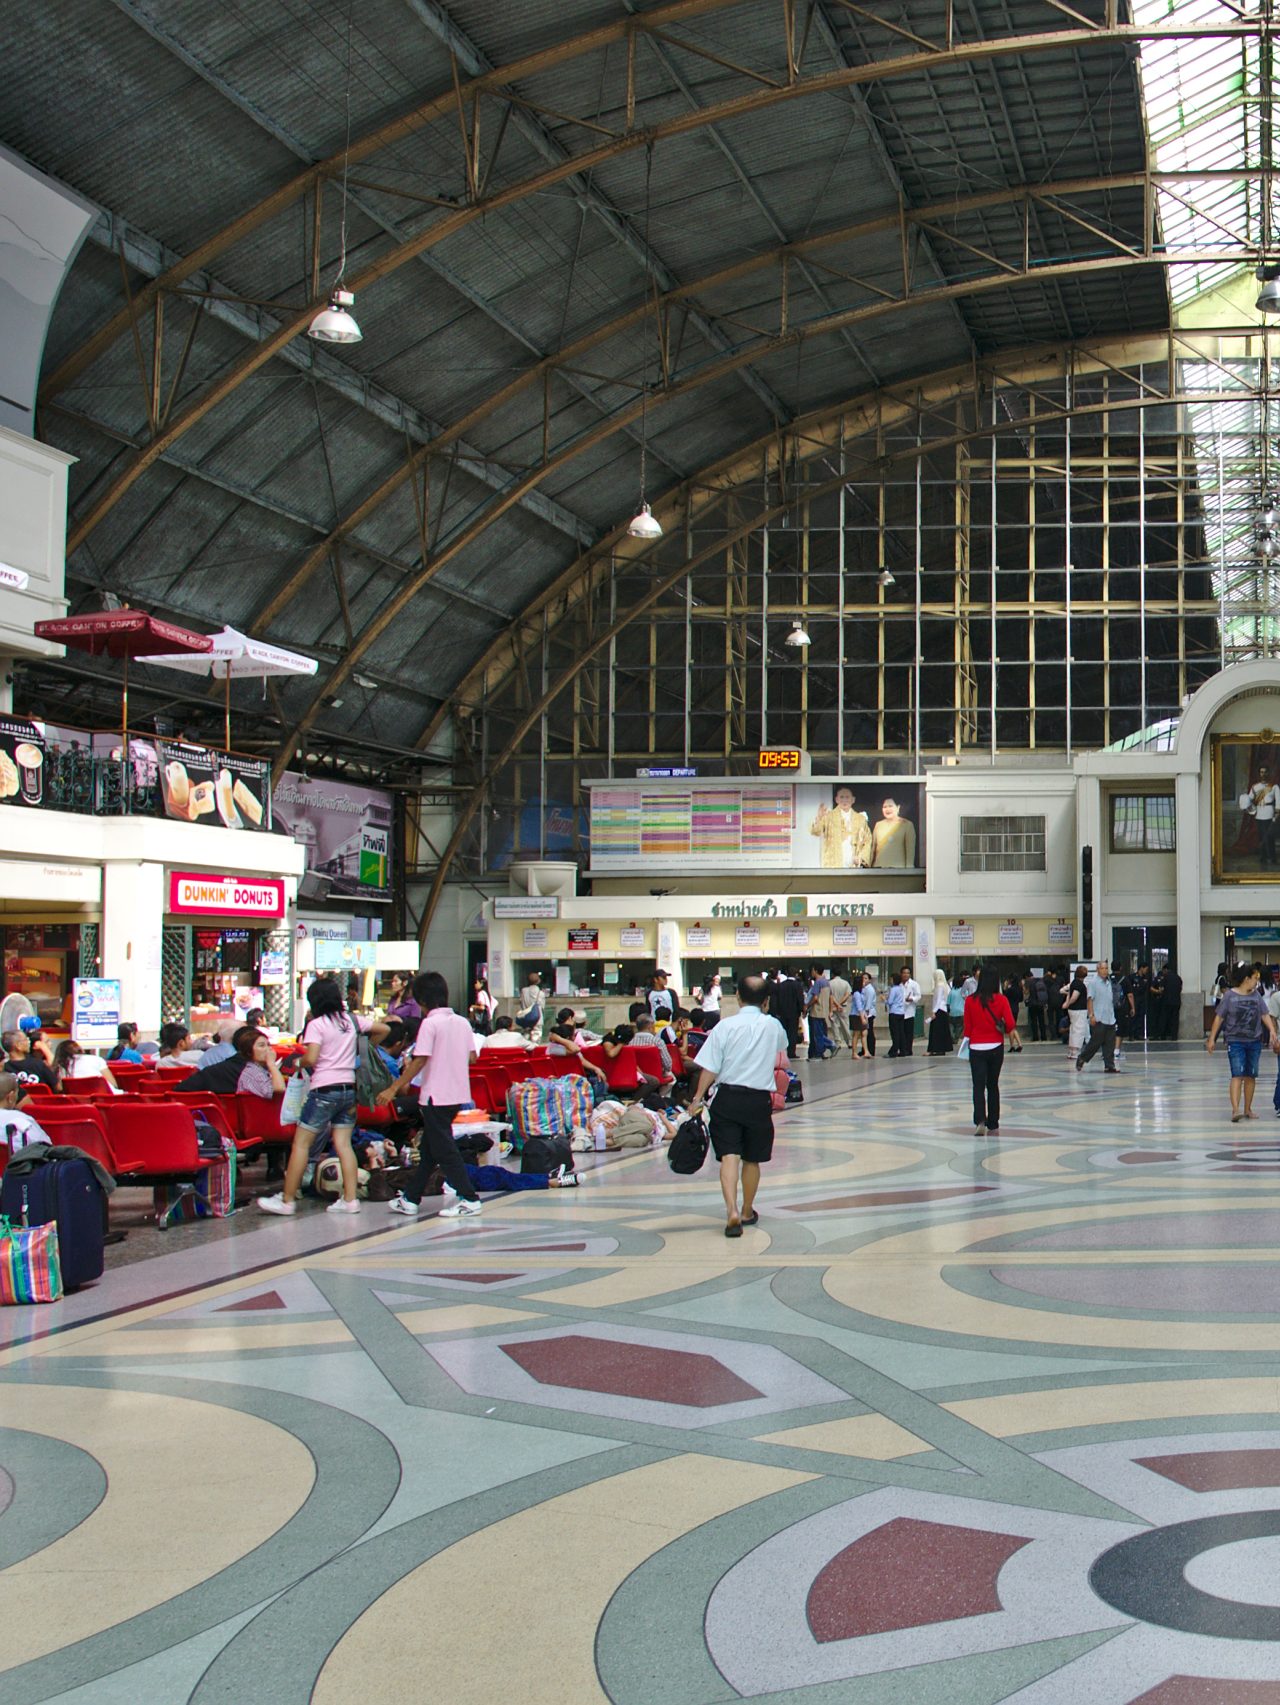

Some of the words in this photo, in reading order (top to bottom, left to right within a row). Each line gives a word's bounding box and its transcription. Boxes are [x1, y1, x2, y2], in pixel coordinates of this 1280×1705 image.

[72, 622, 107, 631] CANON
[759, 752, 799, 767] 09:53
[184, 884, 229, 902] DUNKIN'
[234, 888, 273, 906] DONUTS
[711, 898, 778, 917] จำหน่ายตั๋ว
[817, 903, 874, 916] TICKETS
[312, 927, 328, 938] Dairy
[329, 928, 348, 940] Queen
